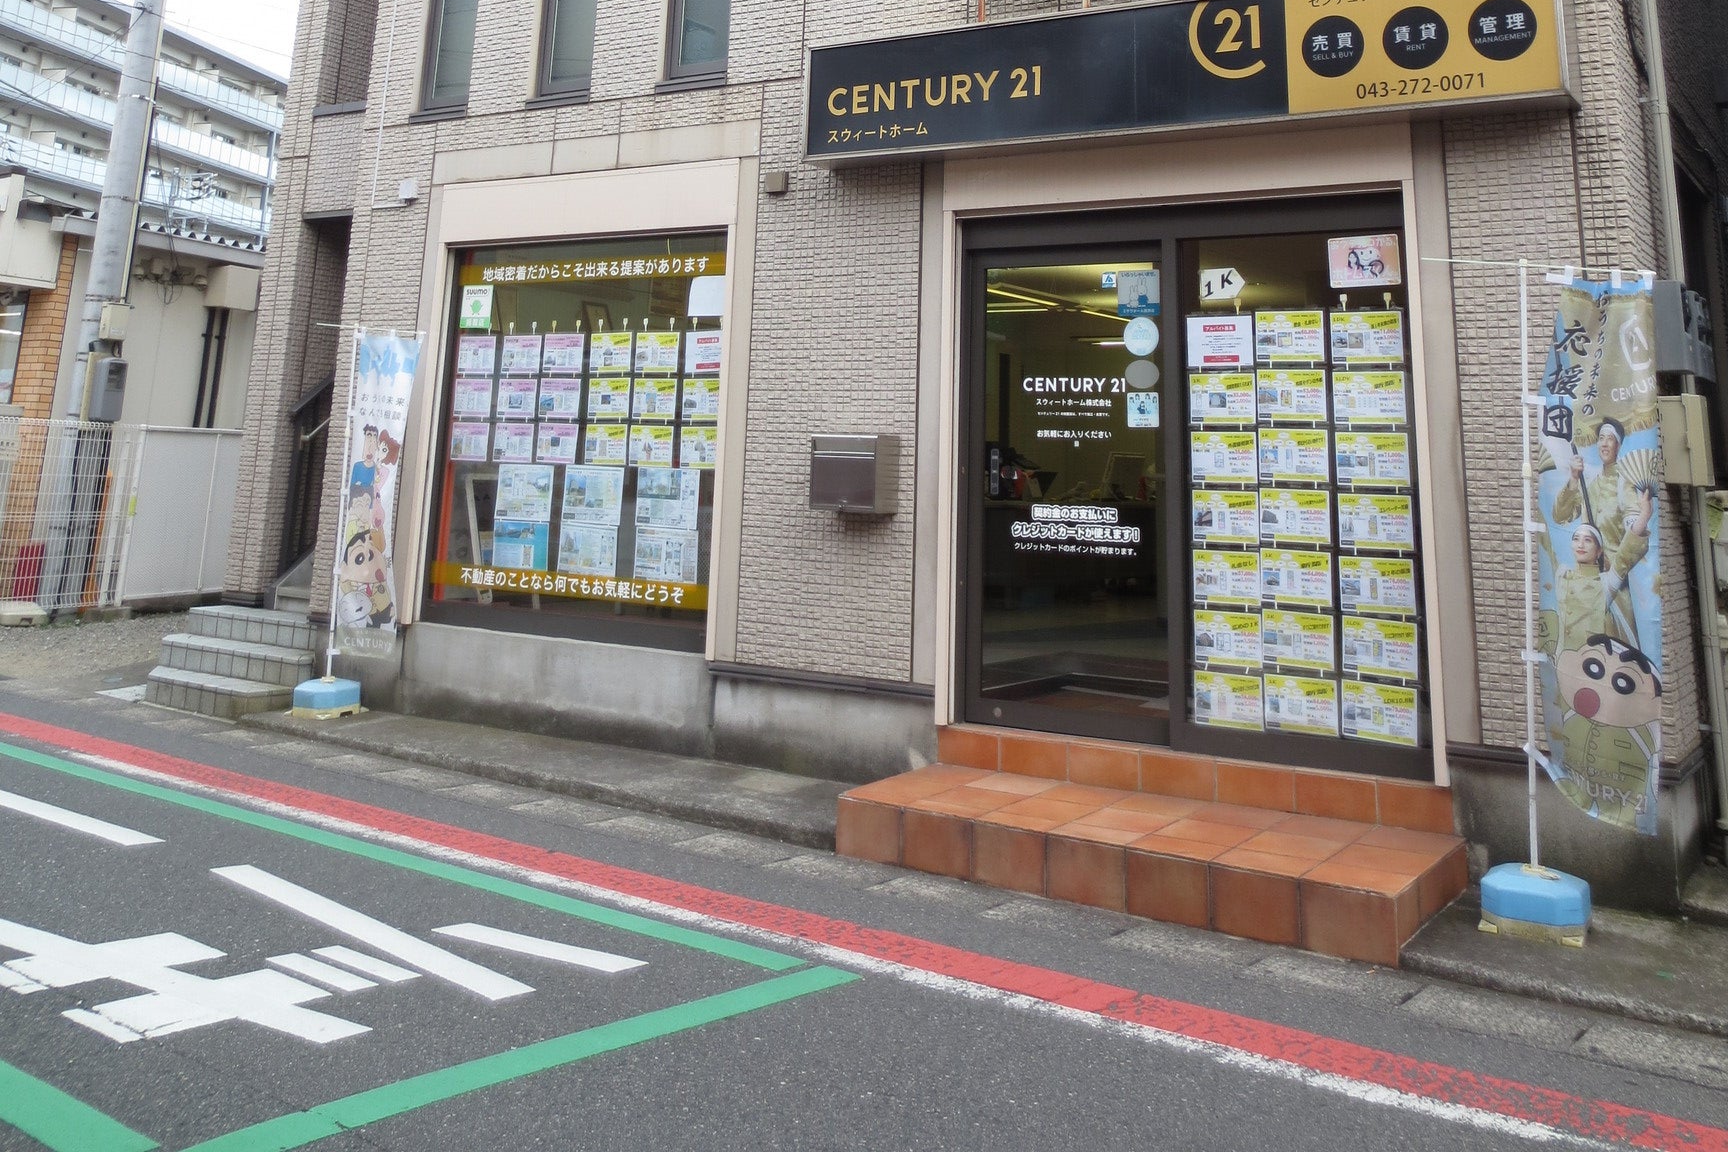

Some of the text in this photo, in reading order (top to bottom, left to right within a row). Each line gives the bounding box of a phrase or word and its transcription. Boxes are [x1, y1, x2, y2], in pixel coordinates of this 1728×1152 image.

[1393, 22, 1437, 44] 賃貸
[1479, 11, 1525, 35] 管理
[1312, 32, 1354, 52] 売買
[1406, 42, 1426, 51] RENT
[1474, 31, 1532, 44] MANAGEMENT
[1312, 53, 1330, 61] SELL
[1338, 51, 1354, 59] BUY
[827, 65, 1042, 116] CENTURY 21
[1356, 72, 1485, 99] 043-272-0071
[827, 121, 928, 144] スウィートホーム
[482, 256, 709, 282] 地域密着だからこそ出来る提案があります
[1022, 377, 1126, 393] CENTURY 21
[1036, 398, 1112, 407] スウィートホーム株式会社
[1036, 429, 1112, 439] お気軽にお入りください
[460, 566, 685, 605] 不動産のことなら何でもお気軽にどうぞ
